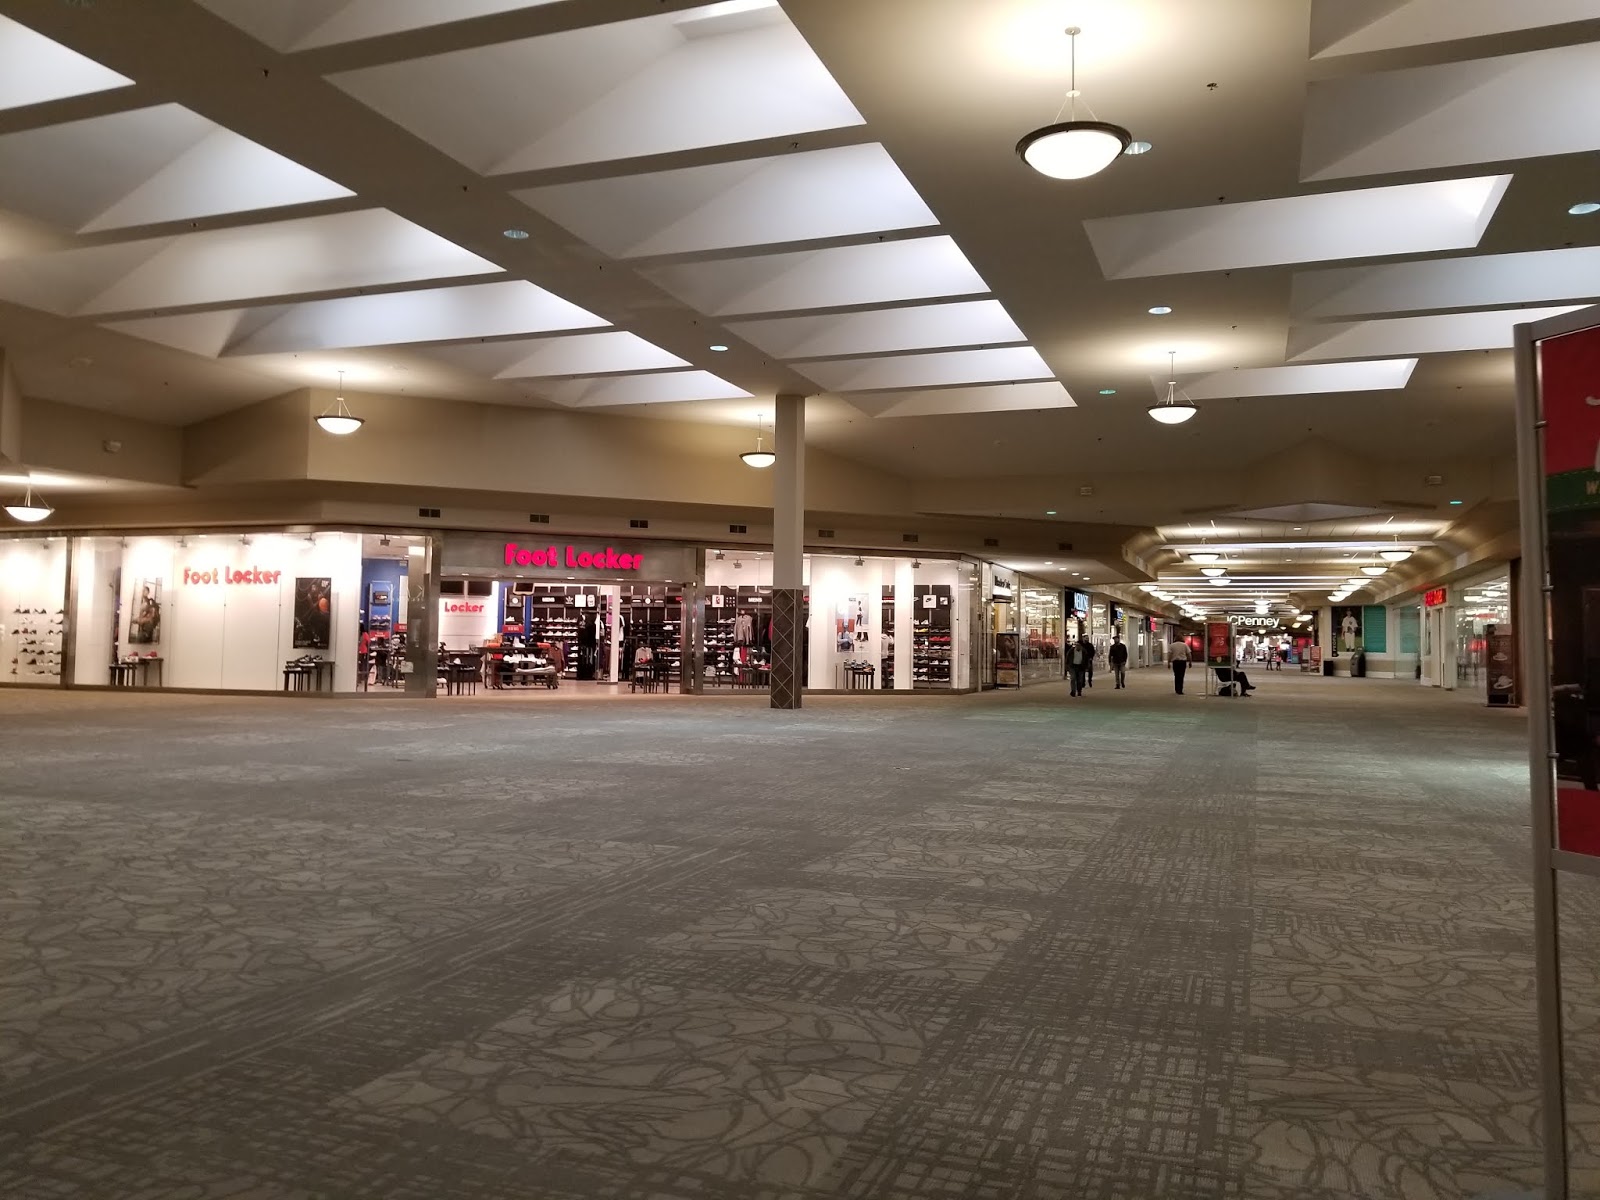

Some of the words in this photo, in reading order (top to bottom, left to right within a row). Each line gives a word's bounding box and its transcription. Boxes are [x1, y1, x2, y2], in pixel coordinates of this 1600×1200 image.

[504, 543, 558, 567] Foot
[566, 545, 644, 570] Locker
[183, 567, 218, 584] Foot
[225, 566, 281, 585] Locker
[444, 601, 484, 613] Locker
